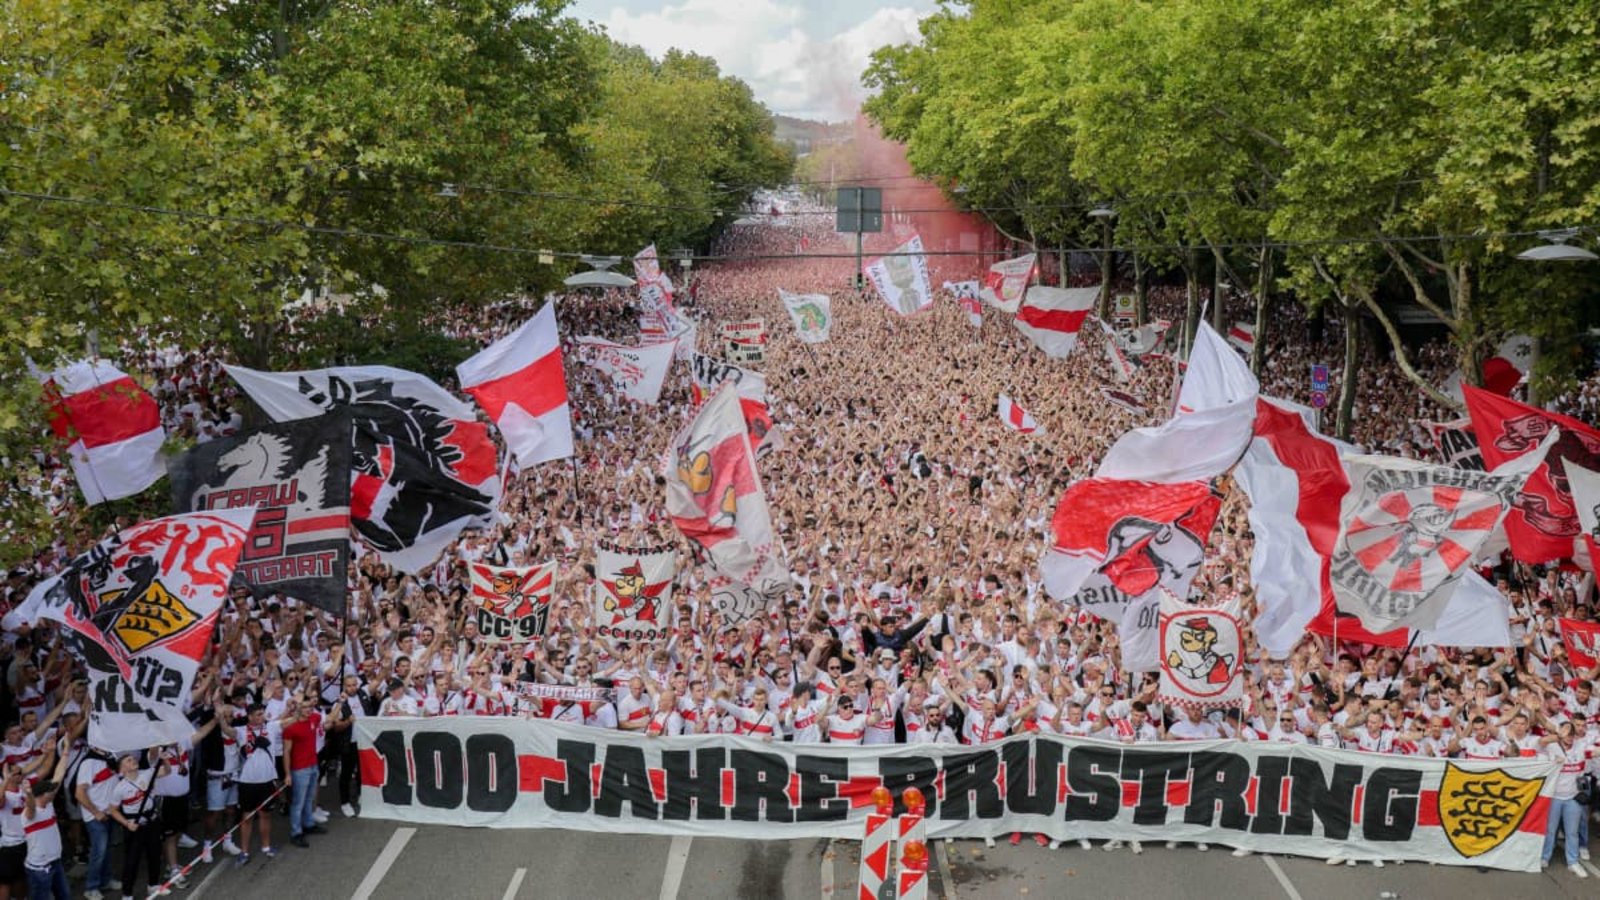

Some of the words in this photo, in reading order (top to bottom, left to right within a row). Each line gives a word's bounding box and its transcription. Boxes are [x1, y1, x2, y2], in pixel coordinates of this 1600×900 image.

[206, 479, 299, 511] CREW
[243, 507, 287, 561] 6
[238, 549, 338, 585] TGART
[530, 685, 597, 700] STUTTGART
[377, 729, 519, 813] 100
[542, 738, 849, 823] JAHRE
[879, 738, 1423, 841] BRUSTRING
